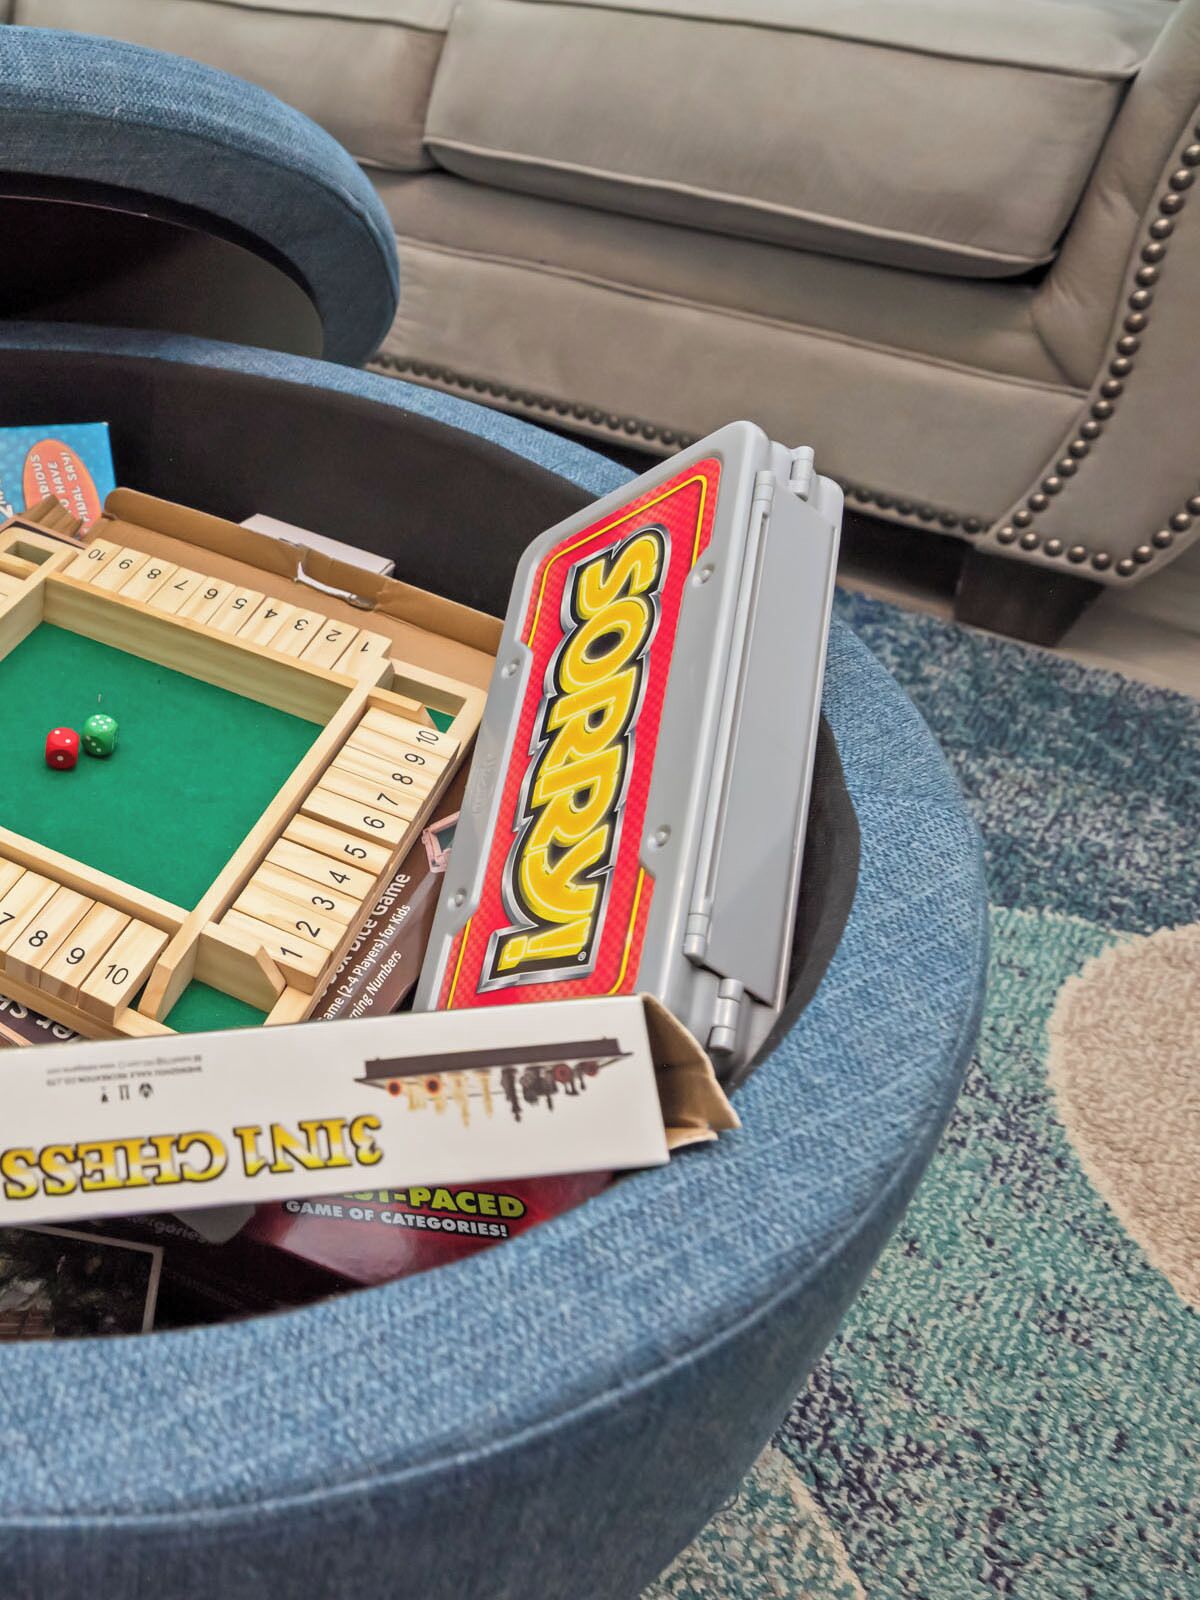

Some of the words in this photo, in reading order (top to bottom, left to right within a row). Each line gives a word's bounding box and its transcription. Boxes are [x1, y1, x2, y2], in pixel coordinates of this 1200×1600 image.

[47, 462, 66, 494] HAVE
[87, 549, 107, 562] 10
[118, 558, 134, 570] 9
[146, 568, 162, 580] 8
[174, 579, 190, 591] 7
[203, 588, 219, 600] 6
[232, 598, 248, 611] 5
[264, 608, 278, 619] 4
[294, 618, 309, 631] 3
[325, 629, 343, 642] 2
[360, 641, 371, 653] 1
[492, 530, 666, 976] SORRY!
[280, 946, 303, 959] 1
[295, 920, 321, 938] 2
[311, 896, 336, 911] 3
[329, 870, 351, 884] 4
[343, 844, 368, 859] 5
[363, 815, 385, 829] 6
[377, 792, 399, 806] 7
[391, 772, 414, 785] 8
[404, 753, 426, 766] 9
[416, 730, 440, 745] 10
[372, 874, 410, 916] Game
[28, 930, 48, 947] 8
[66, 947, 86, 965] 9
[104, 964, 129, 985] 10
[341, 976, 359, 998] (2-4
[354, 938, 388, 977] Players)
[381, 926, 397, 942] for
[391, 904, 411, 927] Kids
[366, 950, 402, 997] Numbers
[232, 1114, 384, 1177] 3IN1
[0, 1130, 228, 1200] CHESS
[285, 1200, 343, 1218] GAME
[349, 1207, 374, 1221] OF
[380, 1211, 508, 1237] CATEGORIES!
